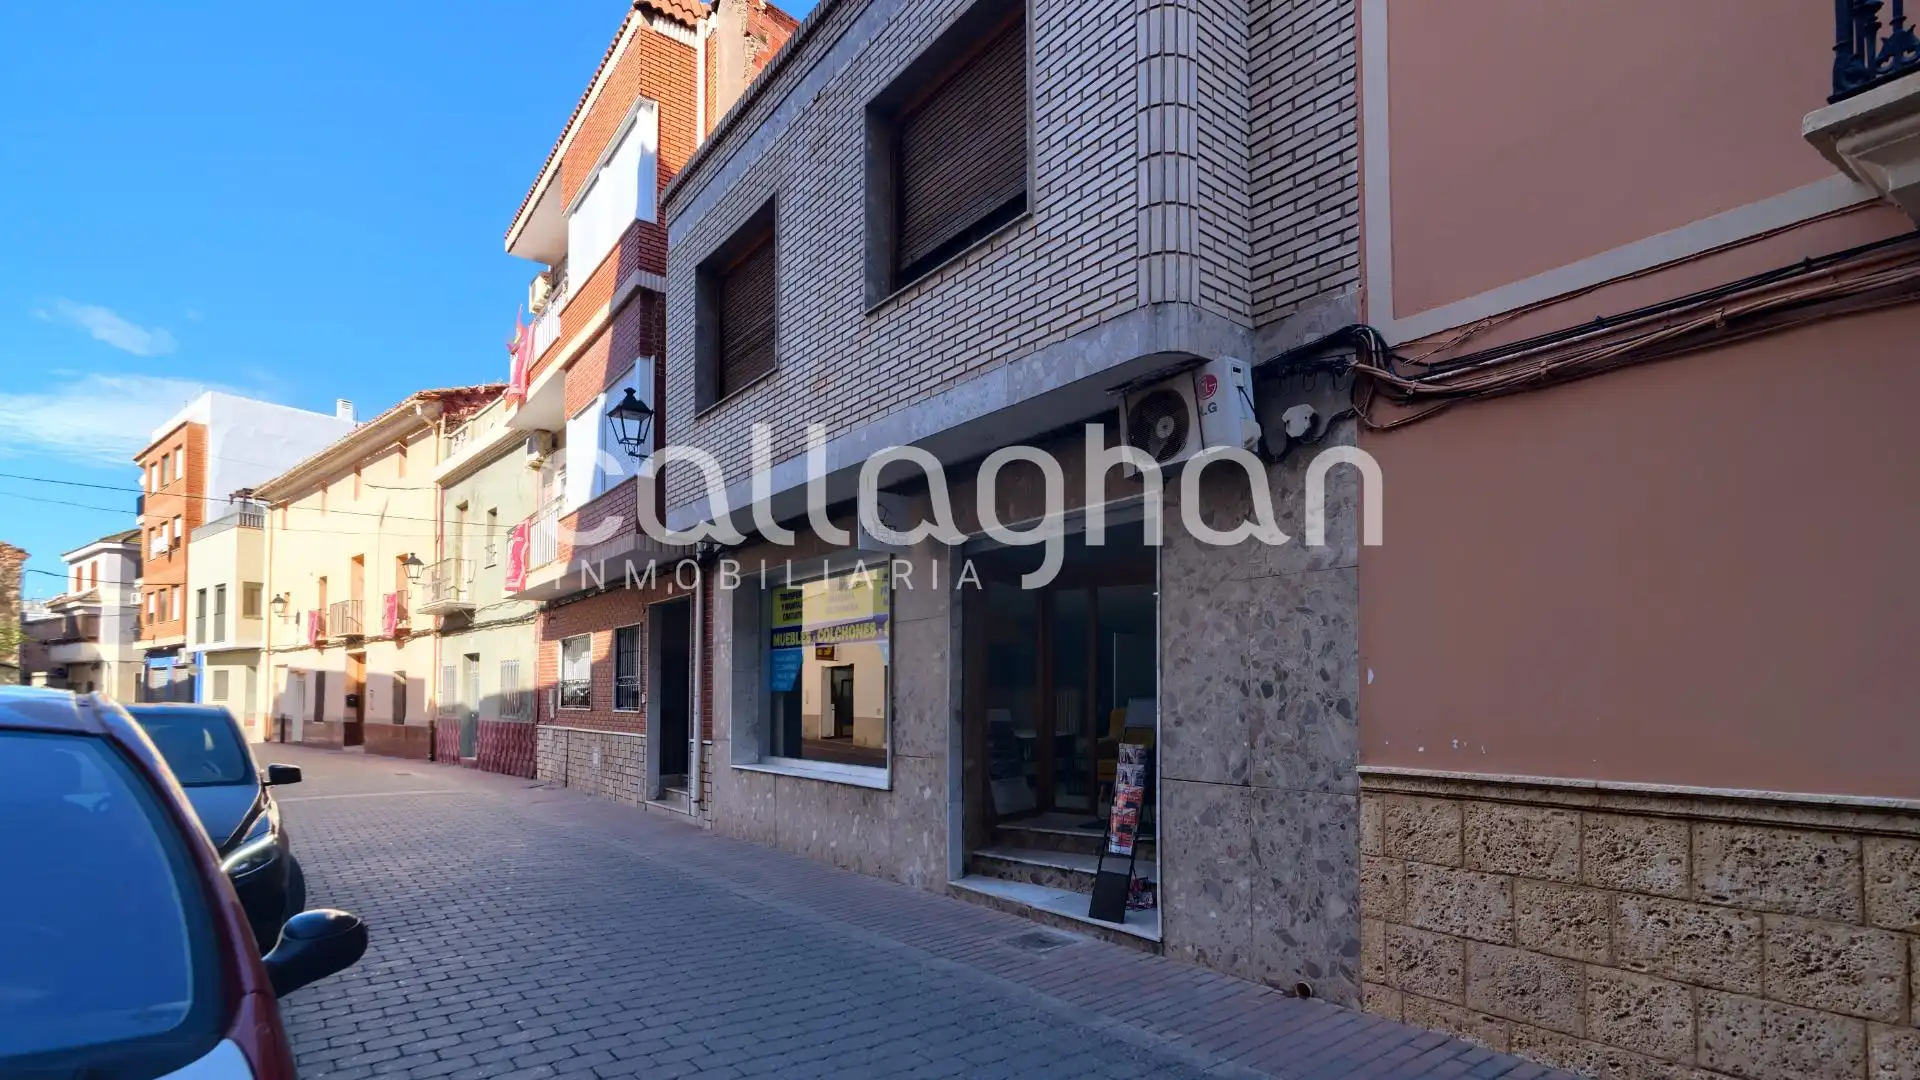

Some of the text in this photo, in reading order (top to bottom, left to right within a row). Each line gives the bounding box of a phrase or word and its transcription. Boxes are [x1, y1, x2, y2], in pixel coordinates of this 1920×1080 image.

[1200, 401, 1217, 416] LG
[773, 629, 811, 647] MUEBLES
[816, 621, 877, 642] COLCHONES
